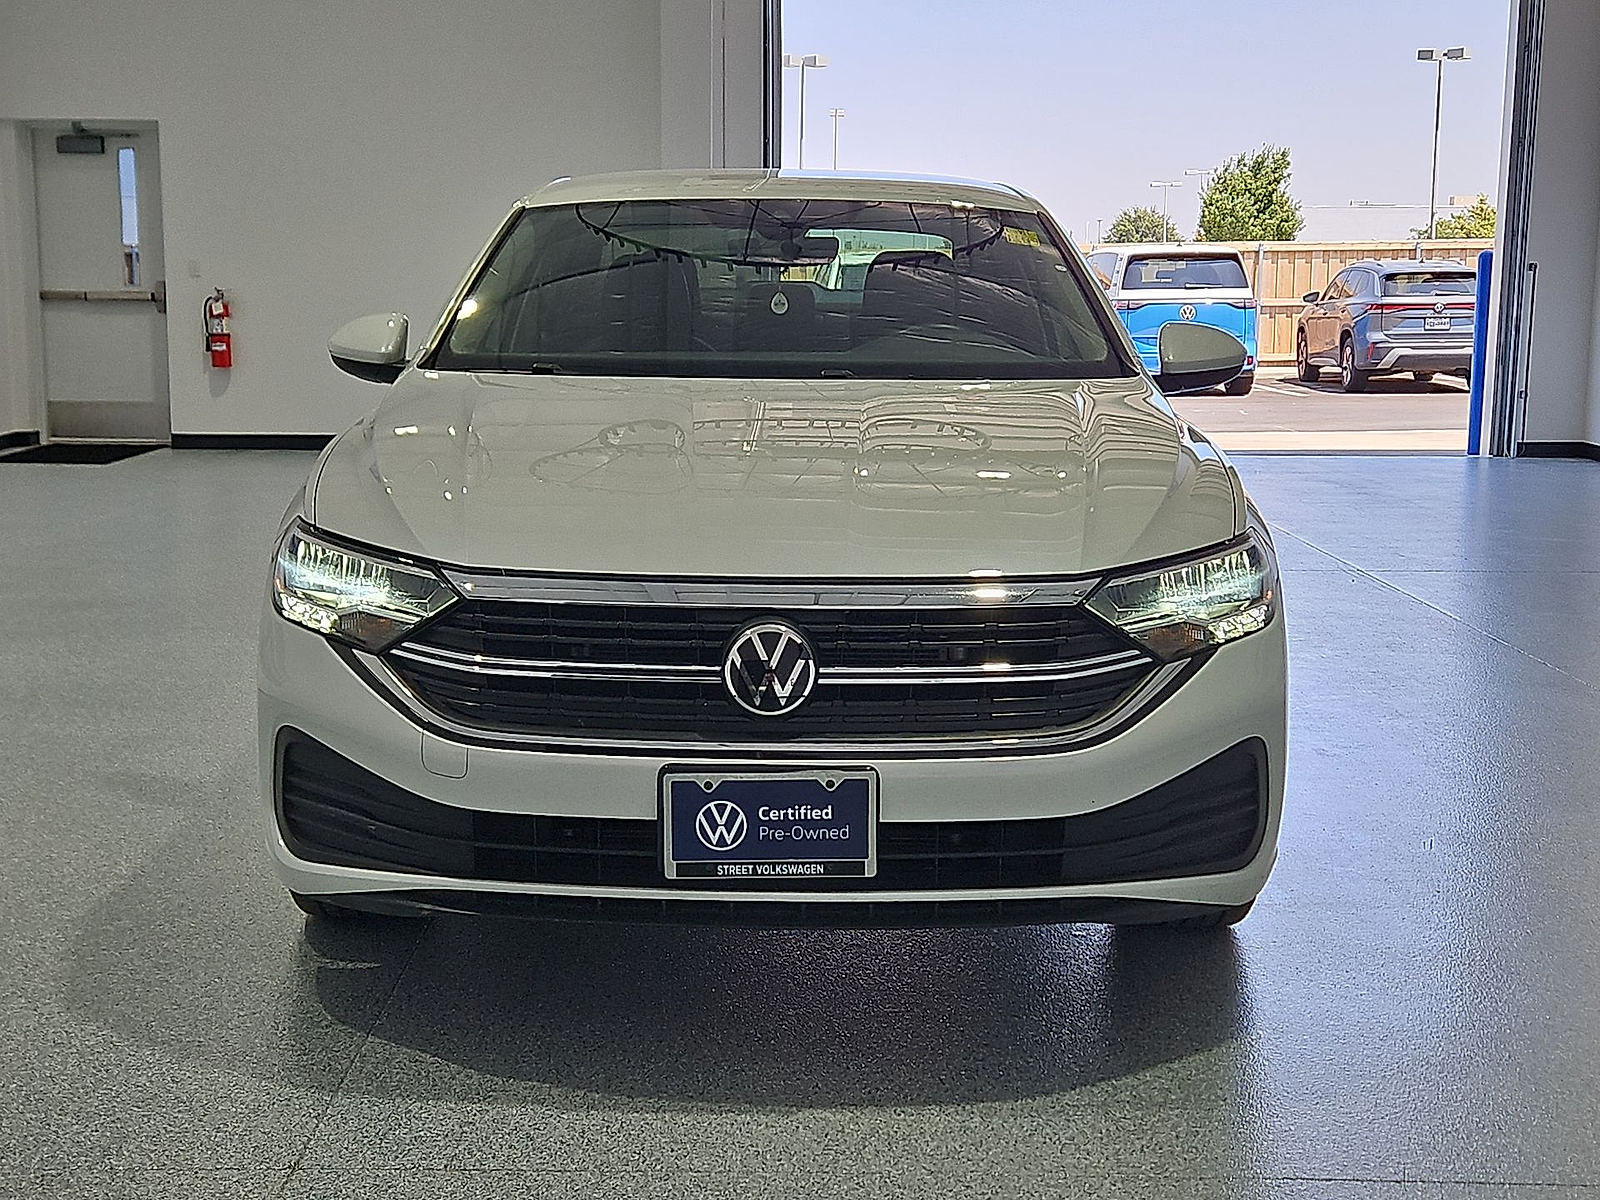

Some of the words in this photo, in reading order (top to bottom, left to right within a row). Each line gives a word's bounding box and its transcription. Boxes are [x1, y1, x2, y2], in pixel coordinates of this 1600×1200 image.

[758, 805, 832, 819] Certified
[759, 825, 849, 840] Pre-Owned
[717, 864, 753, 875] STREET
[756, 863, 824, 875] VOLKSWAGEN
